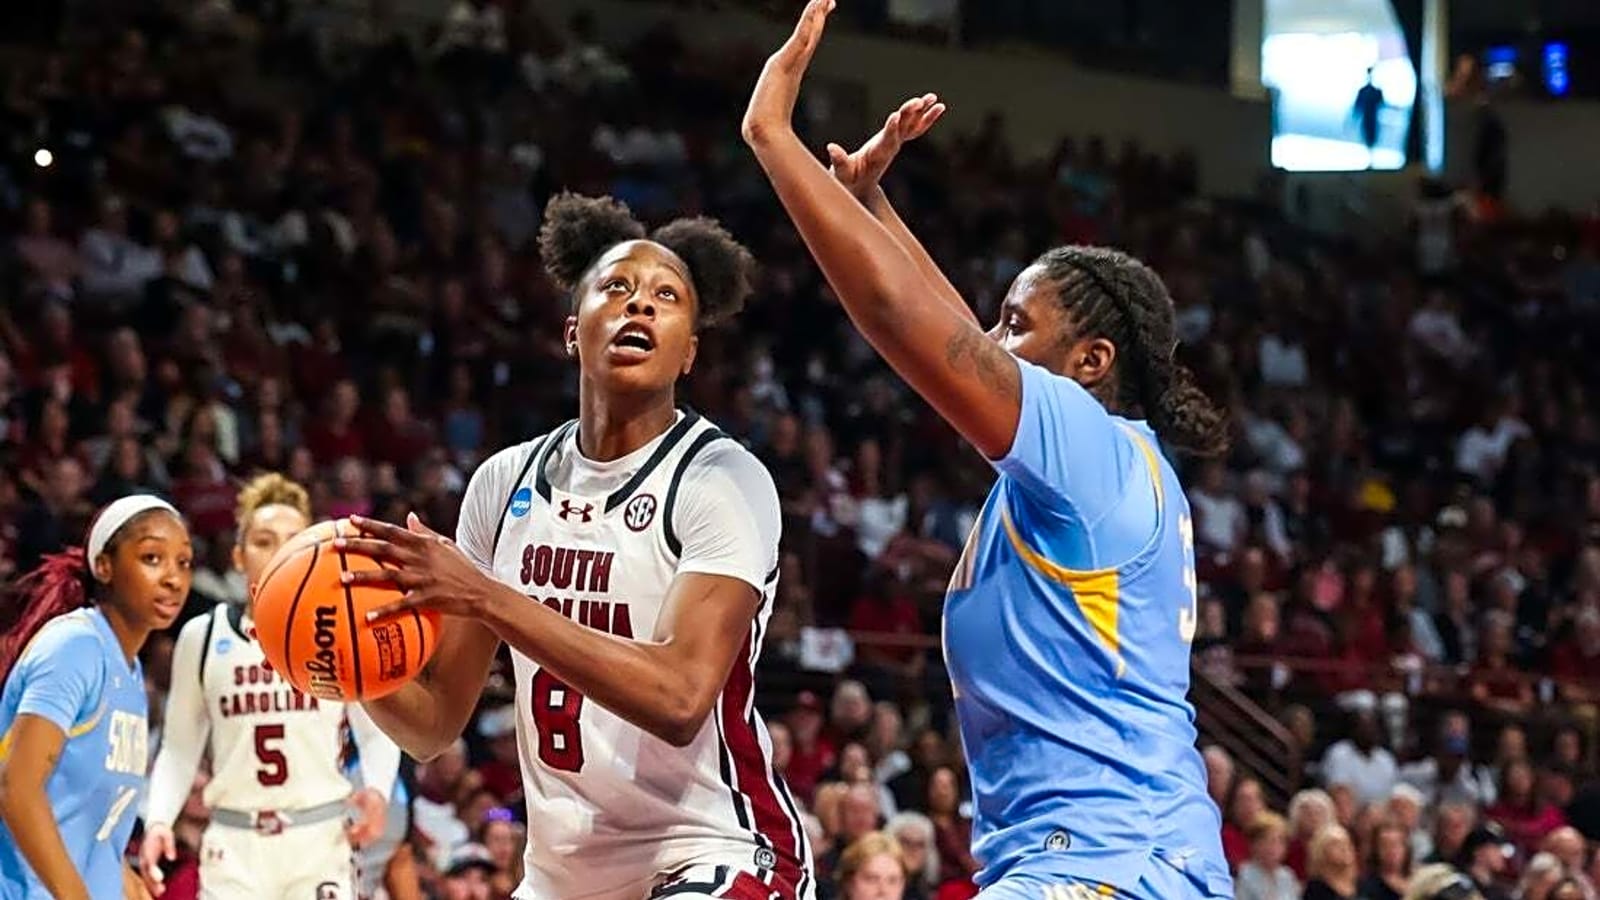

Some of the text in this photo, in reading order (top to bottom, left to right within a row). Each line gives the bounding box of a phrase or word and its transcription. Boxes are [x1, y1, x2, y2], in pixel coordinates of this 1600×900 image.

[628, 496, 651, 527] SEC
[520, 543, 615, 593] SOUTH
[306, 605, 344, 698] Wilson
[531, 665, 585, 774] 8
[254, 724, 289, 787] 5
